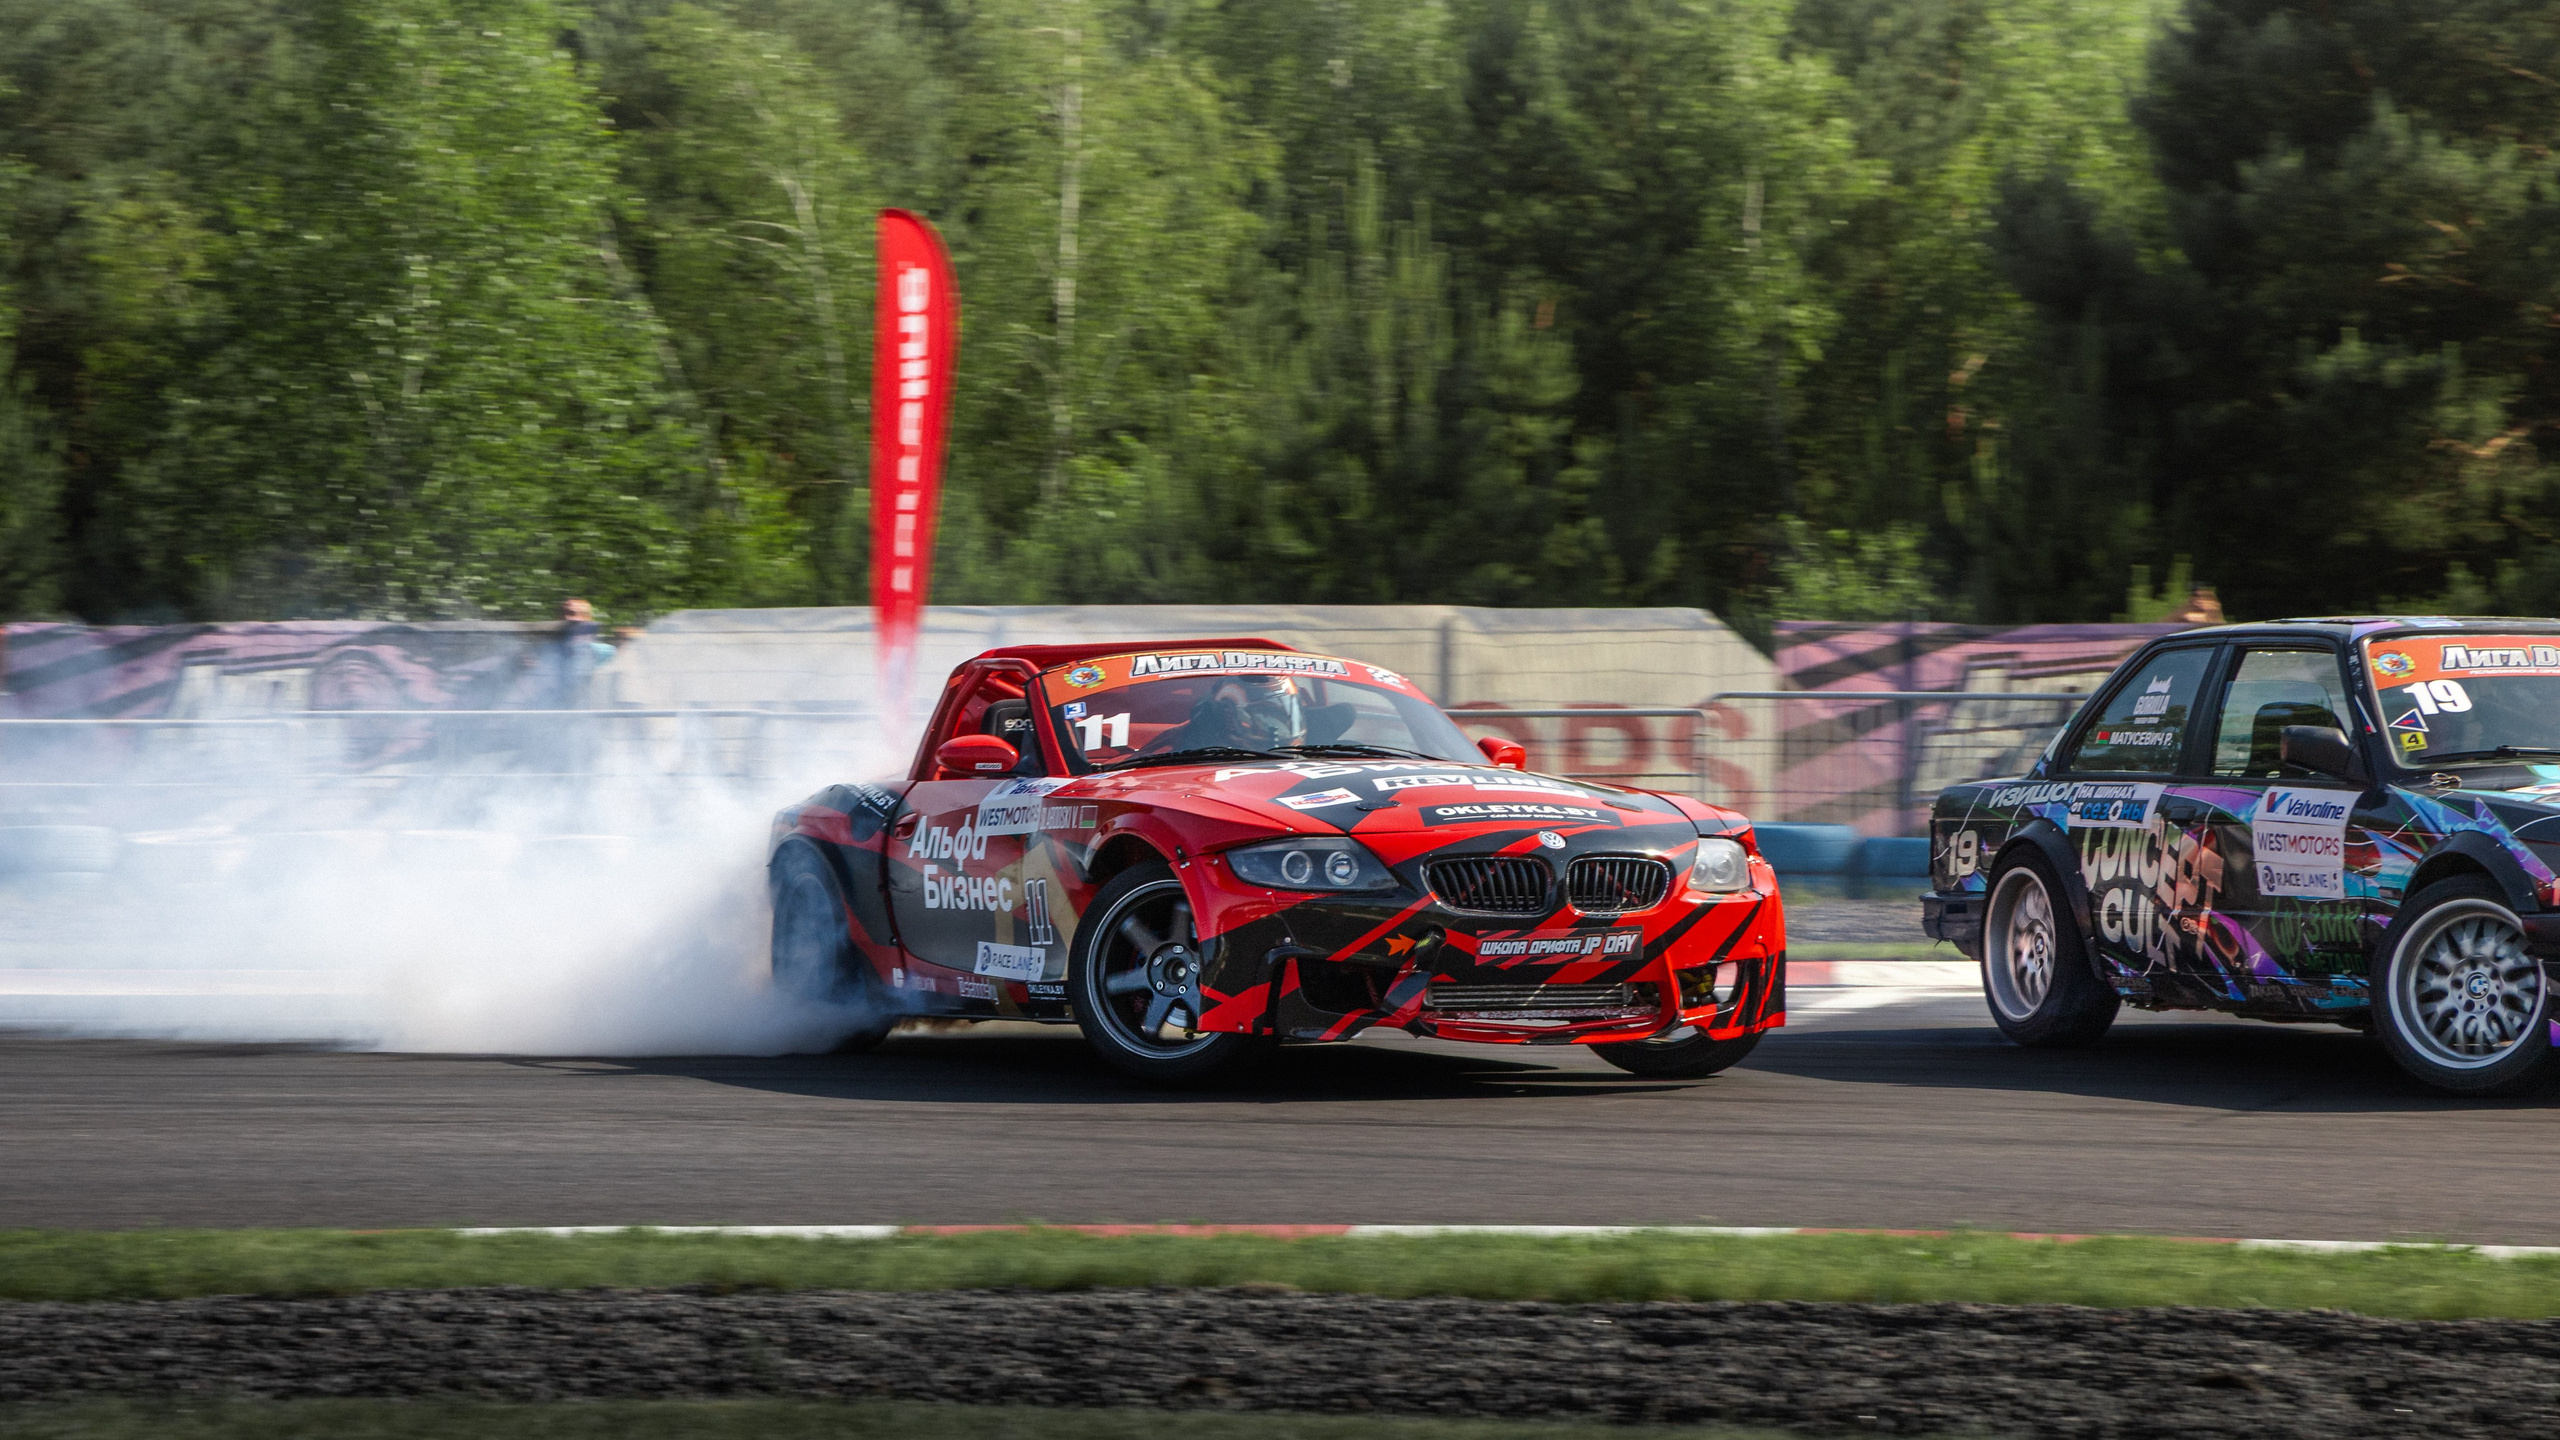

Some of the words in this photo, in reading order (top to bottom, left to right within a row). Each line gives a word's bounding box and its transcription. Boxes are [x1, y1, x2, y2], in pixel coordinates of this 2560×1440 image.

[2403, 680, 2472, 715] 19
[1075, 713, 1131, 751] 11
[2408, 734, 2419, 745] 4
[1435, 804, 1598, 818] OKLEYKA.BY
[2286, 798, 2345, 820] Valvoline
[908, 814, 987, 872] Альфа
[1950, 830, 1977, 876] 19
[2257, 832, 2340, 856] WESTMOTORS
[924, 865, 1013, 912] Бизнес
[1480, 941, 1528, 955] ШКОЛА
[1528, 939, 1582, 955] ДРИФТА
[1580, 936, 1602, 955] JP
[1603, 934, 1639, 954] DAY
